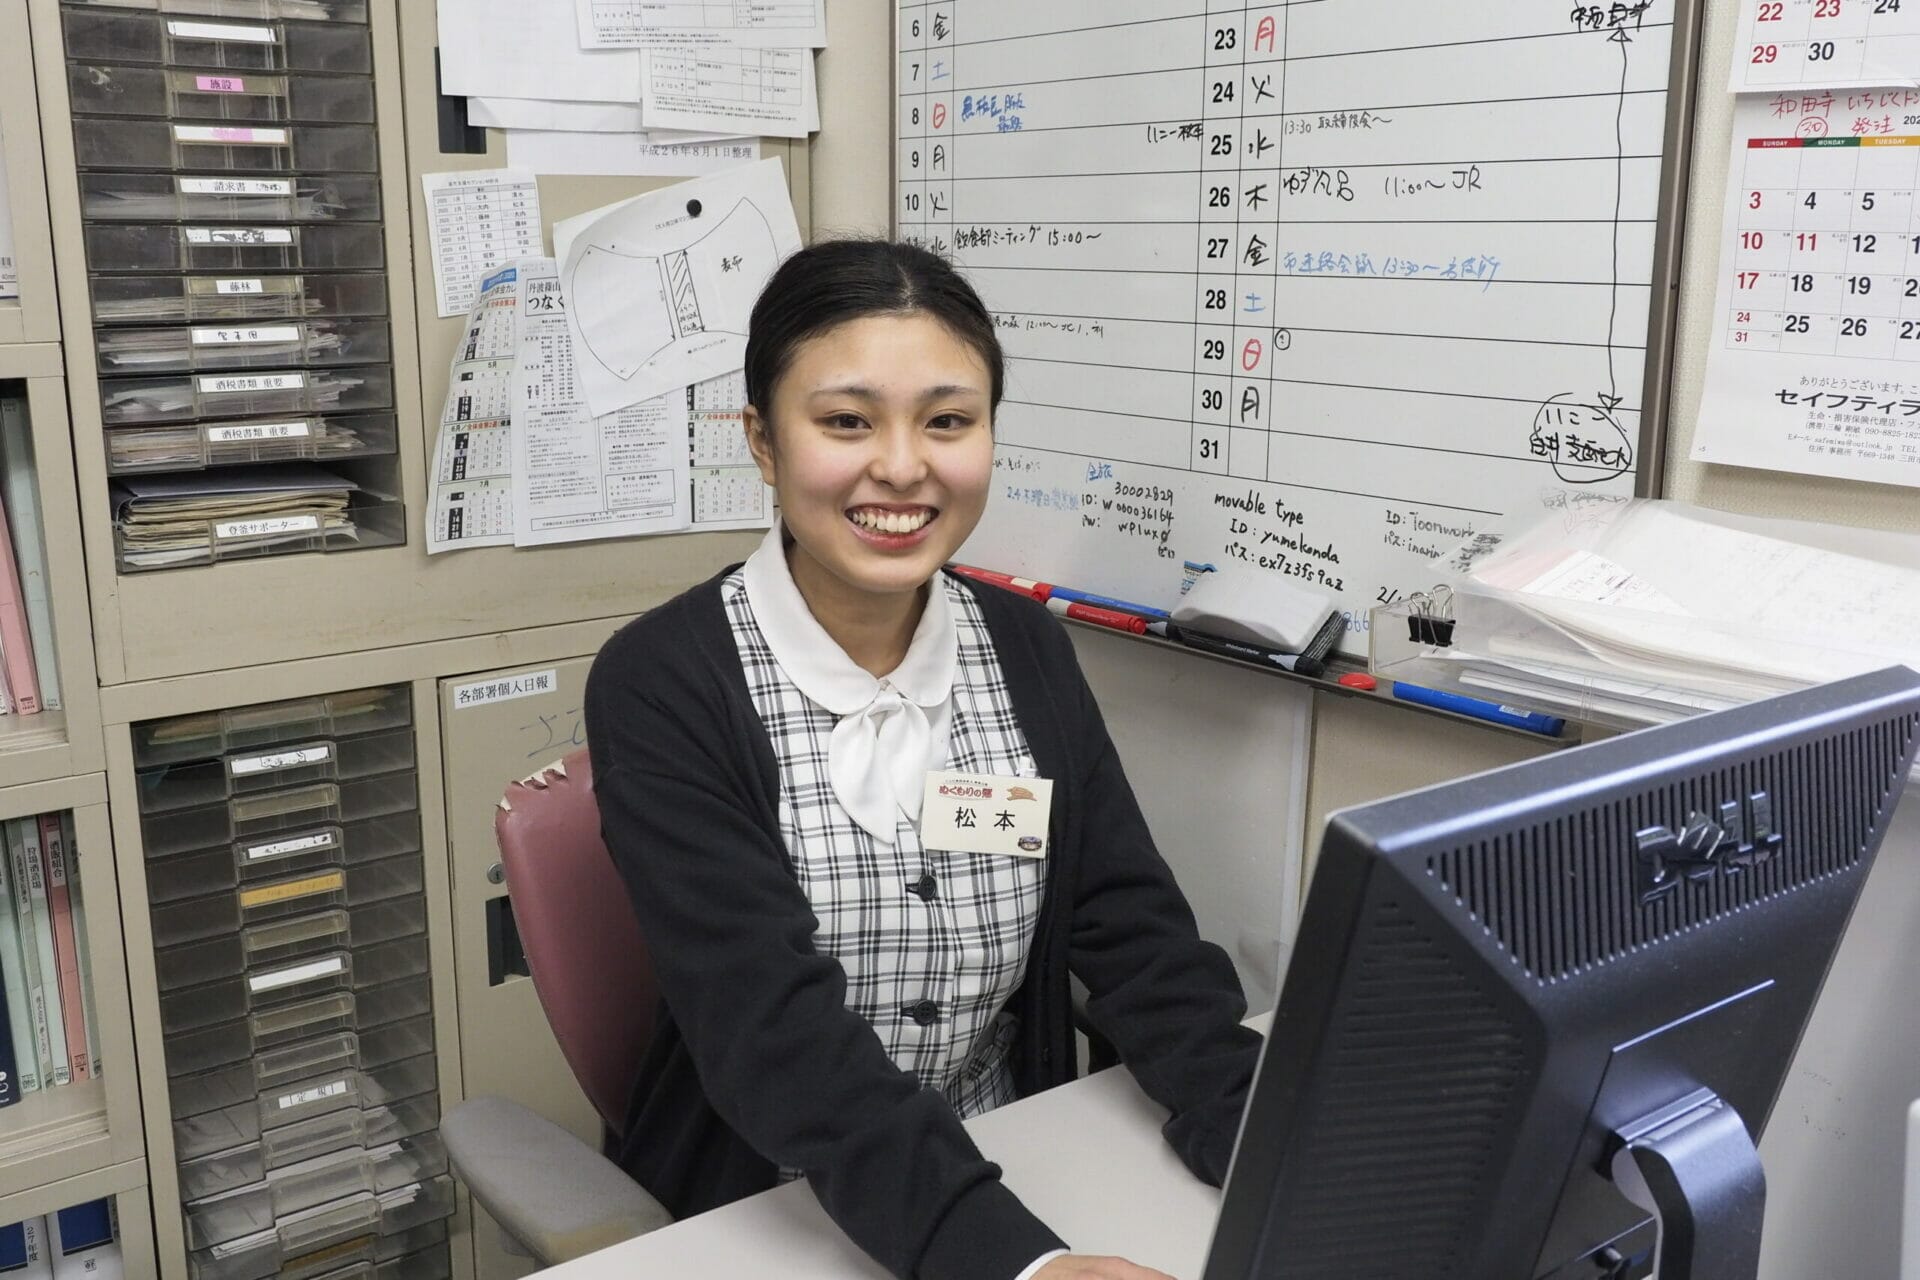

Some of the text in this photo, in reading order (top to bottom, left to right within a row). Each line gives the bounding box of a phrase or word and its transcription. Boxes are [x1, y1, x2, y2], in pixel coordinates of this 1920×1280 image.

[1757, 0, 1901, 22] 22 23 24
[912, 12, 951, 41] 6 金
[1214, 16, 1275, 53] 23 月
[1751, 42, 1835, 64] 29 30
[912, 64, 920, 80] 7
[1212, 75, 1275, 103] 24 火
[912, 108, 920, 125] 8
[933, 103, 946, 129] 日
[639, 143, 752, 159] 平成26年8月1日整理
[1210, 134, 1232, 156] 25
[1249, 129, 1275, 159] 水
[912, 144, 945, 171] 9 月
[1208, 187, 1231, 208] 26
[1245, 183, 1268, 212] 木
[1452, 164, 1482, 193] JR
[1750, 191, 1875, 211] 3 4 5
[905, 191, 948, 218] 10 火
[1207, 239, 1229, 259] 27
[1244, 234, 1270, 267] 金
[1741, 231, 1764, 250] 10
[1796, 233, 1817, 251] 11
[1852, 234, 1877, 253] 12
[1737, 272, 1760, 290] 17
[1791, 274, 1814, 292] 18
[1848, 276, 1871, 295] 19
[1205, 289, 1267, 313] 28 土
[1735, 331, 1748, 343] 31
[1736, 311, 1752, 323] 24
[1784, 314, 1811, 333] 25
[1840, 317, 1868, 337] 26
[1203, 338, 1262, 371] 29 日
[1201, 386, 1260, 424] 30 月
[1199, 438, 1219, 459] 31
[1902, 444, 1918, 455] TEL
[1081, 493, 1098, 506] ID:
[1214, 489, 1305, 528] movable type
[457, 675, 549, 704] 各部署個人日報
